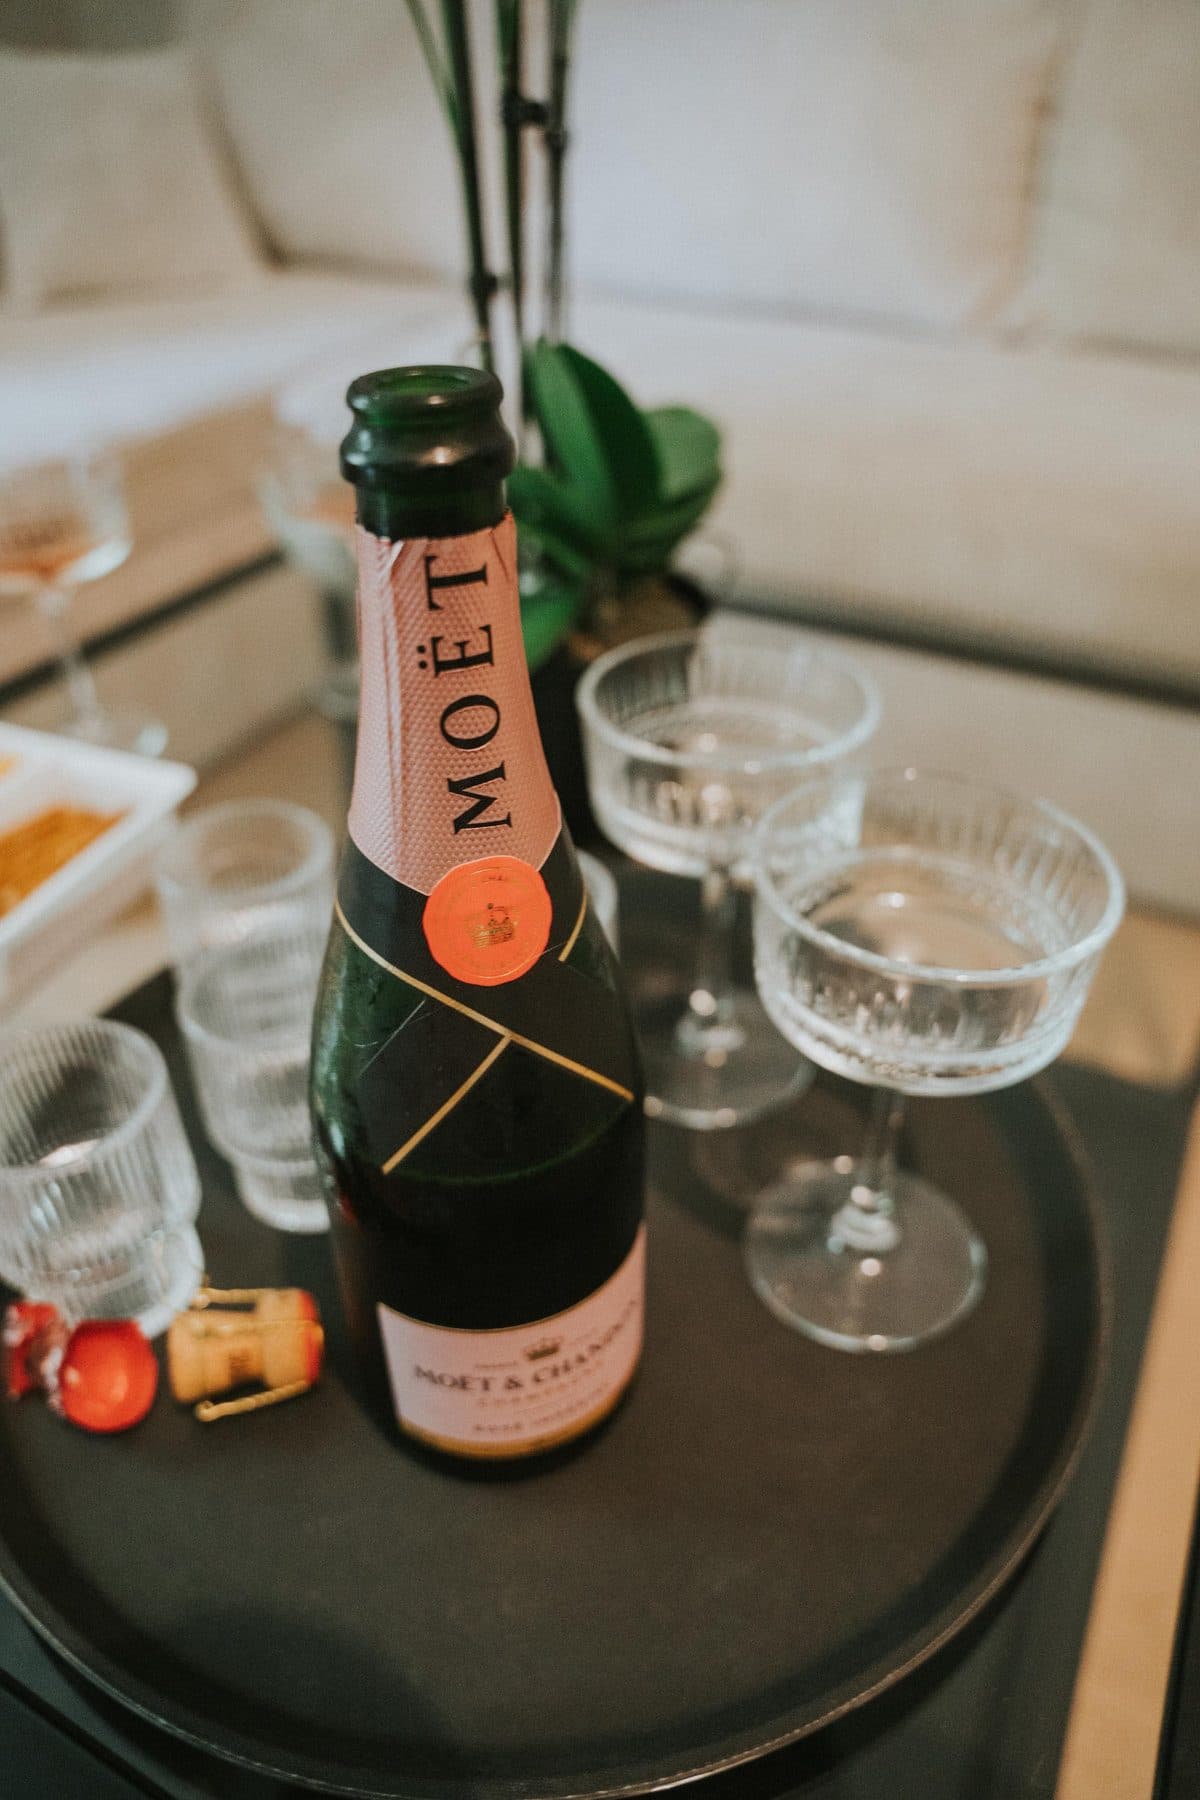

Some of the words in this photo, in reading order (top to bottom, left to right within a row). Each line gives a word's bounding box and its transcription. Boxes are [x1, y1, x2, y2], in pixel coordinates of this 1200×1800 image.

[416, 555, 513, 836] MOËT
[503, 1376, 525, 1392] &
[532, 1298, 638, 1386] CHAN
